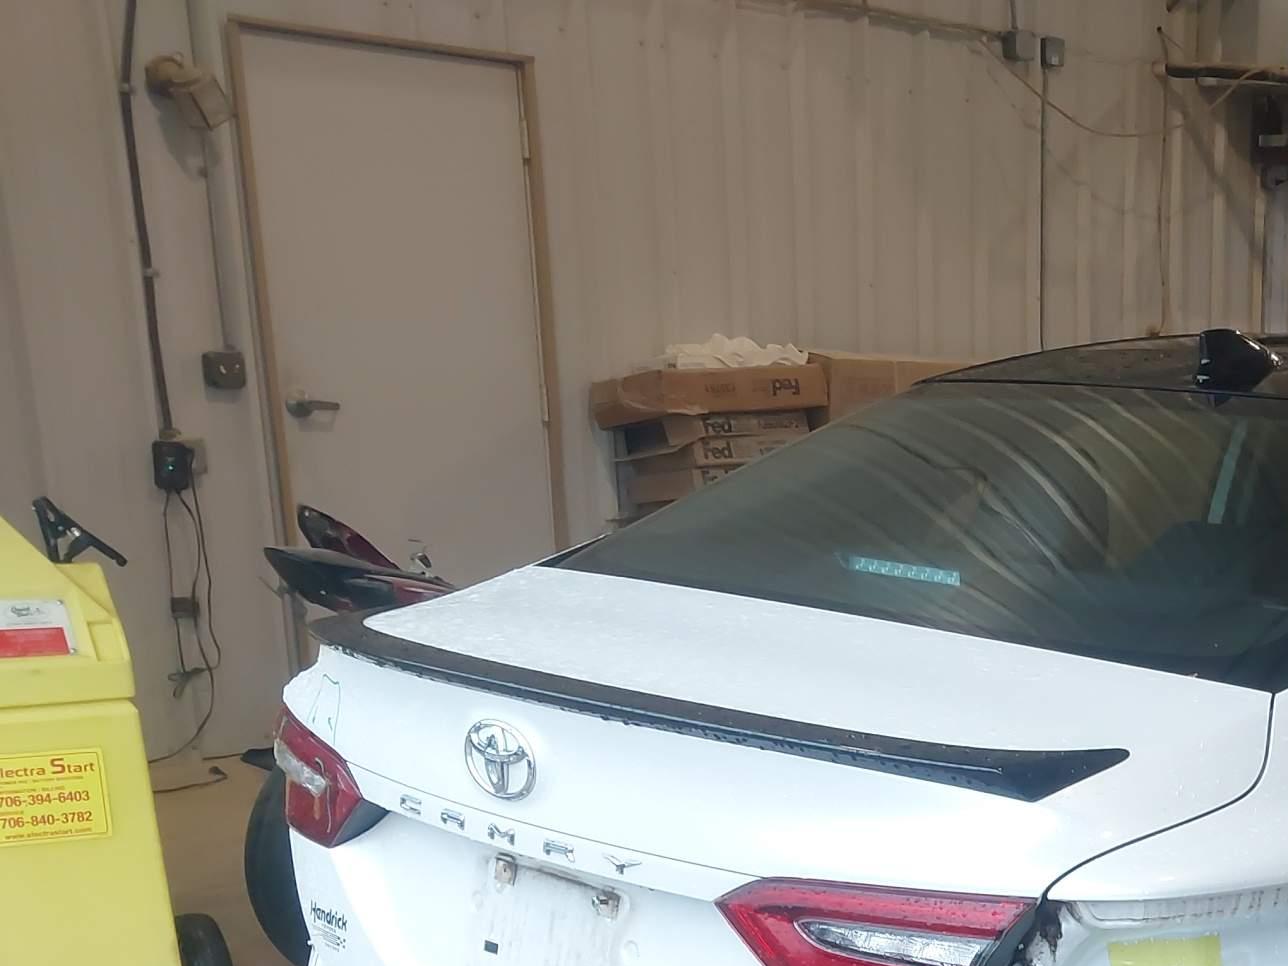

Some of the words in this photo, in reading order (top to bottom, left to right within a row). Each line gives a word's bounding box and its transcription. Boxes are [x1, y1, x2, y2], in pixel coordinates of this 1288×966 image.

[772, 378, 800, 396] Fed
[702, 416, 733, 436] Fed
[702, 440, 733, 460] Fed
[0, 766, 46, 779] lectra
[49, 757, 95, 775] Start
[0, 790, 90, 808] 706-394-6403
[1, 810, 94, 830] 706-840-3782
[400, 793, 641, 875] CAMRY
[310, 899, 348, 932] Hendrick
